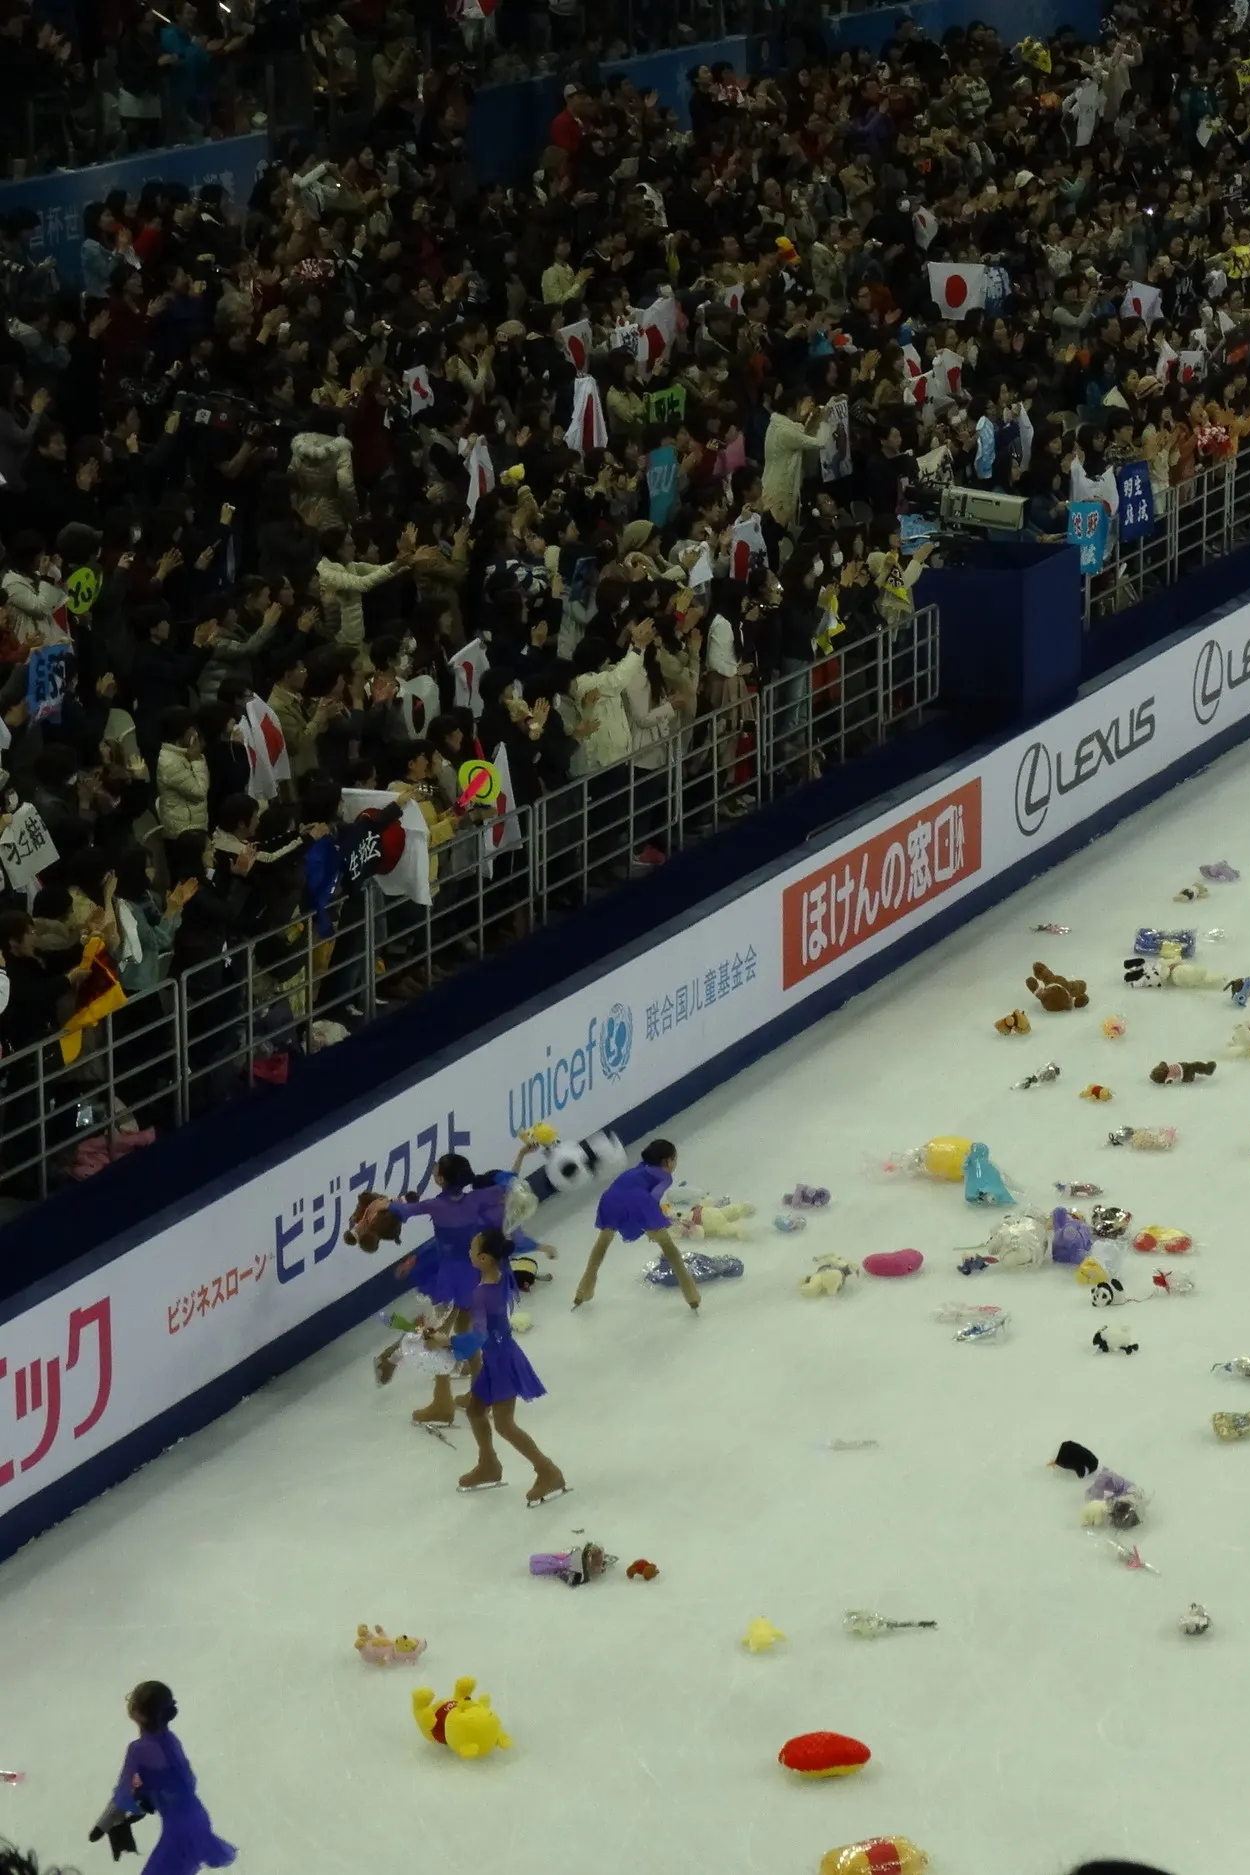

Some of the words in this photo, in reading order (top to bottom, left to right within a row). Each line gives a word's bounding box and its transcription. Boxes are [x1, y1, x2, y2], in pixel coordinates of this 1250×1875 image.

[1056, 696, 1155, 796] LEXUS
[802, 804, 964, 966] ほけんの窓口
[646, 944, 757, 1041] 联合国儿童基金会
[509, 1017, 597, 1138] unicef
[168, 1254, 267, 1334] ビジネスローン
[0, 1296, 112, 1488] ック
